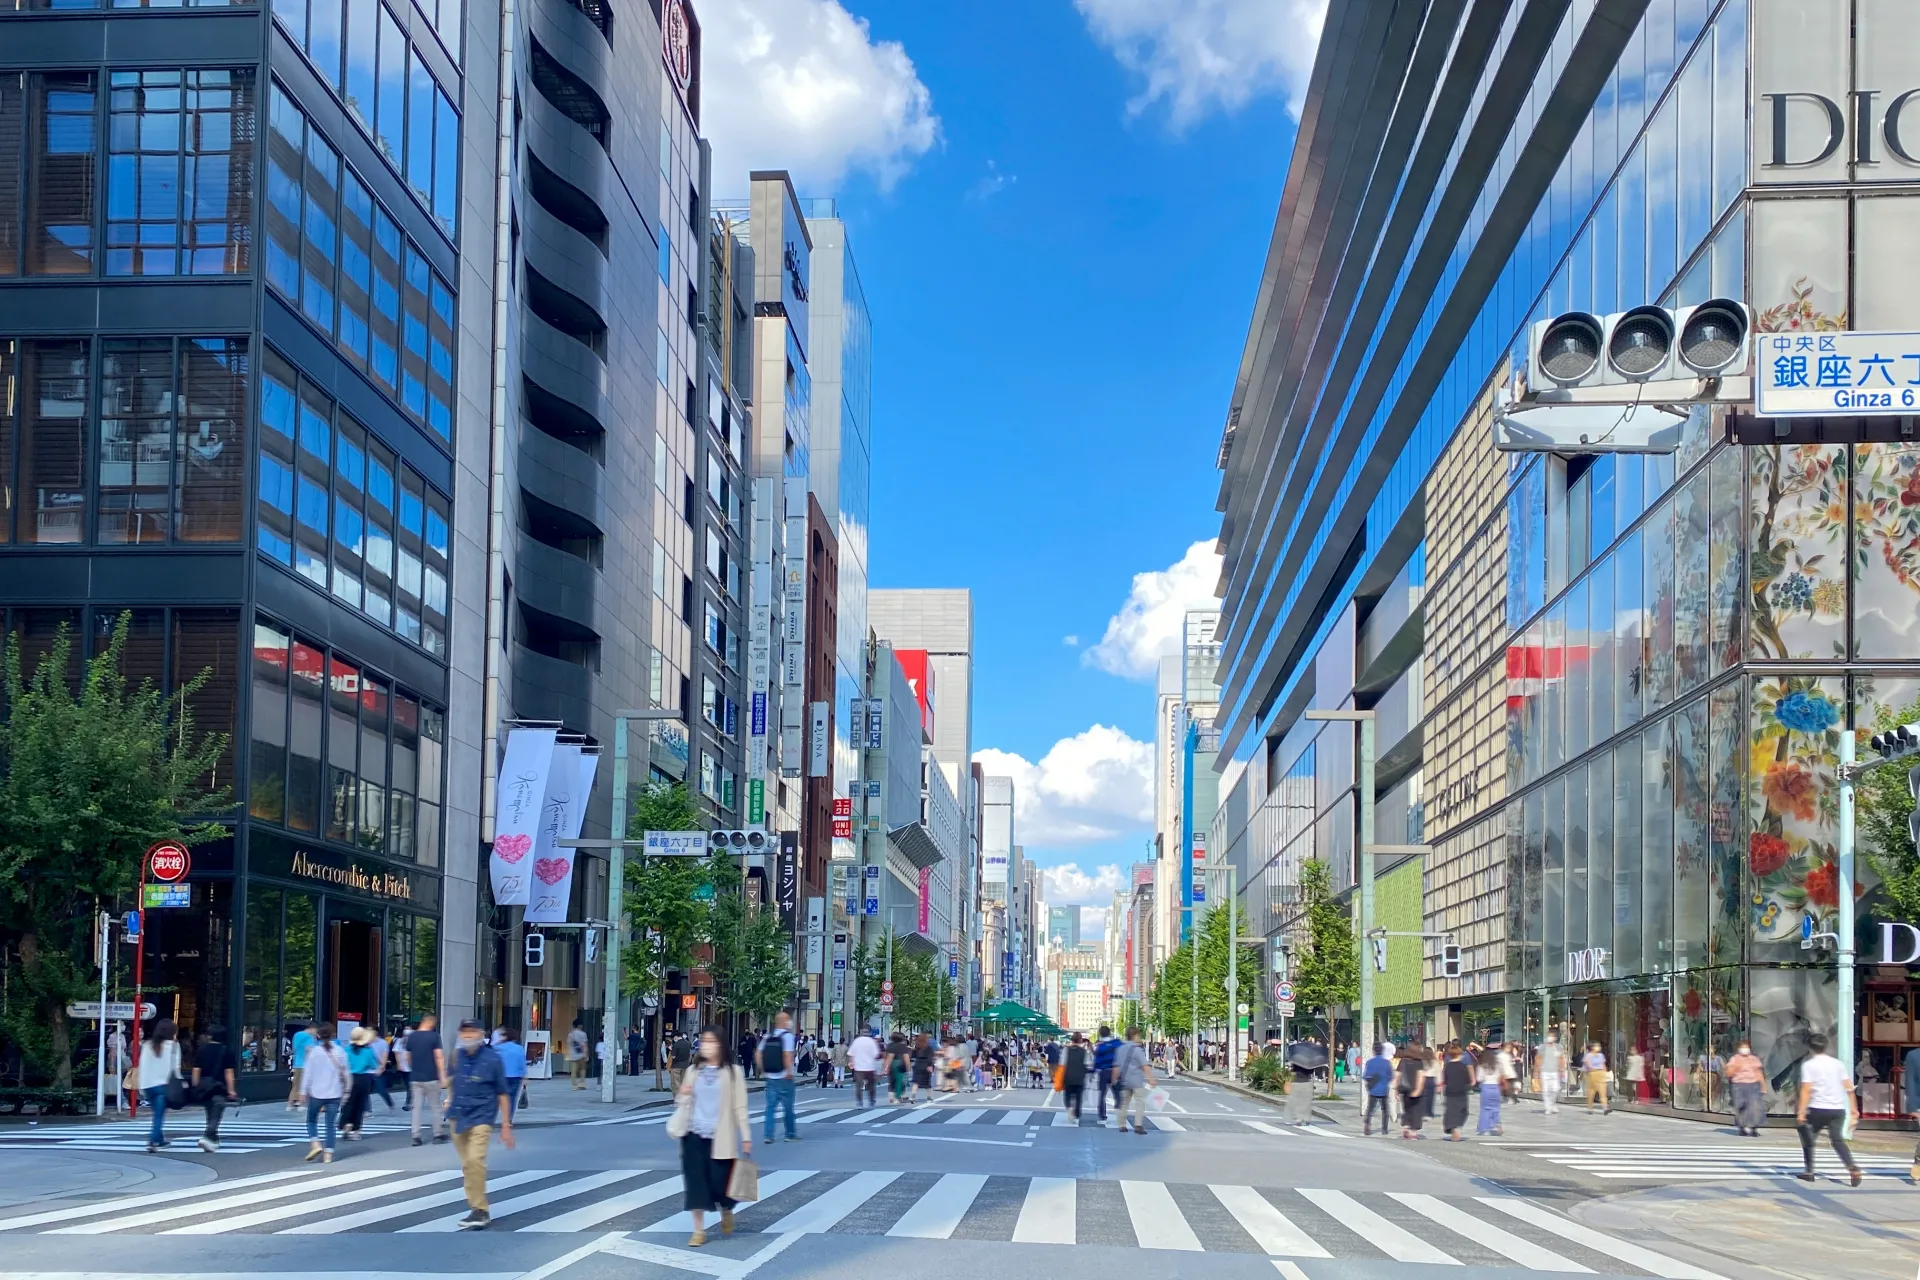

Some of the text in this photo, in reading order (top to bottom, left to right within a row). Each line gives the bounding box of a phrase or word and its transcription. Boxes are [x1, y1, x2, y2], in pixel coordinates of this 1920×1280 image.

[1773, 336, 1836, 352] 中央区
[1834, 389, 1915, 408] Ginza 6
[815, 726, 824, 758] DIANA
[525, 790, 533, 808] GINZA
[648, 837, 703, 848] 銀座六丁目
[155, 857, 181, 869] 消火栓
[291, 850, 411, 899] Abercrombie & Fitch
[747, 890, 757, 919] マギー
[1568, 948, 1606, 983] DIOR
